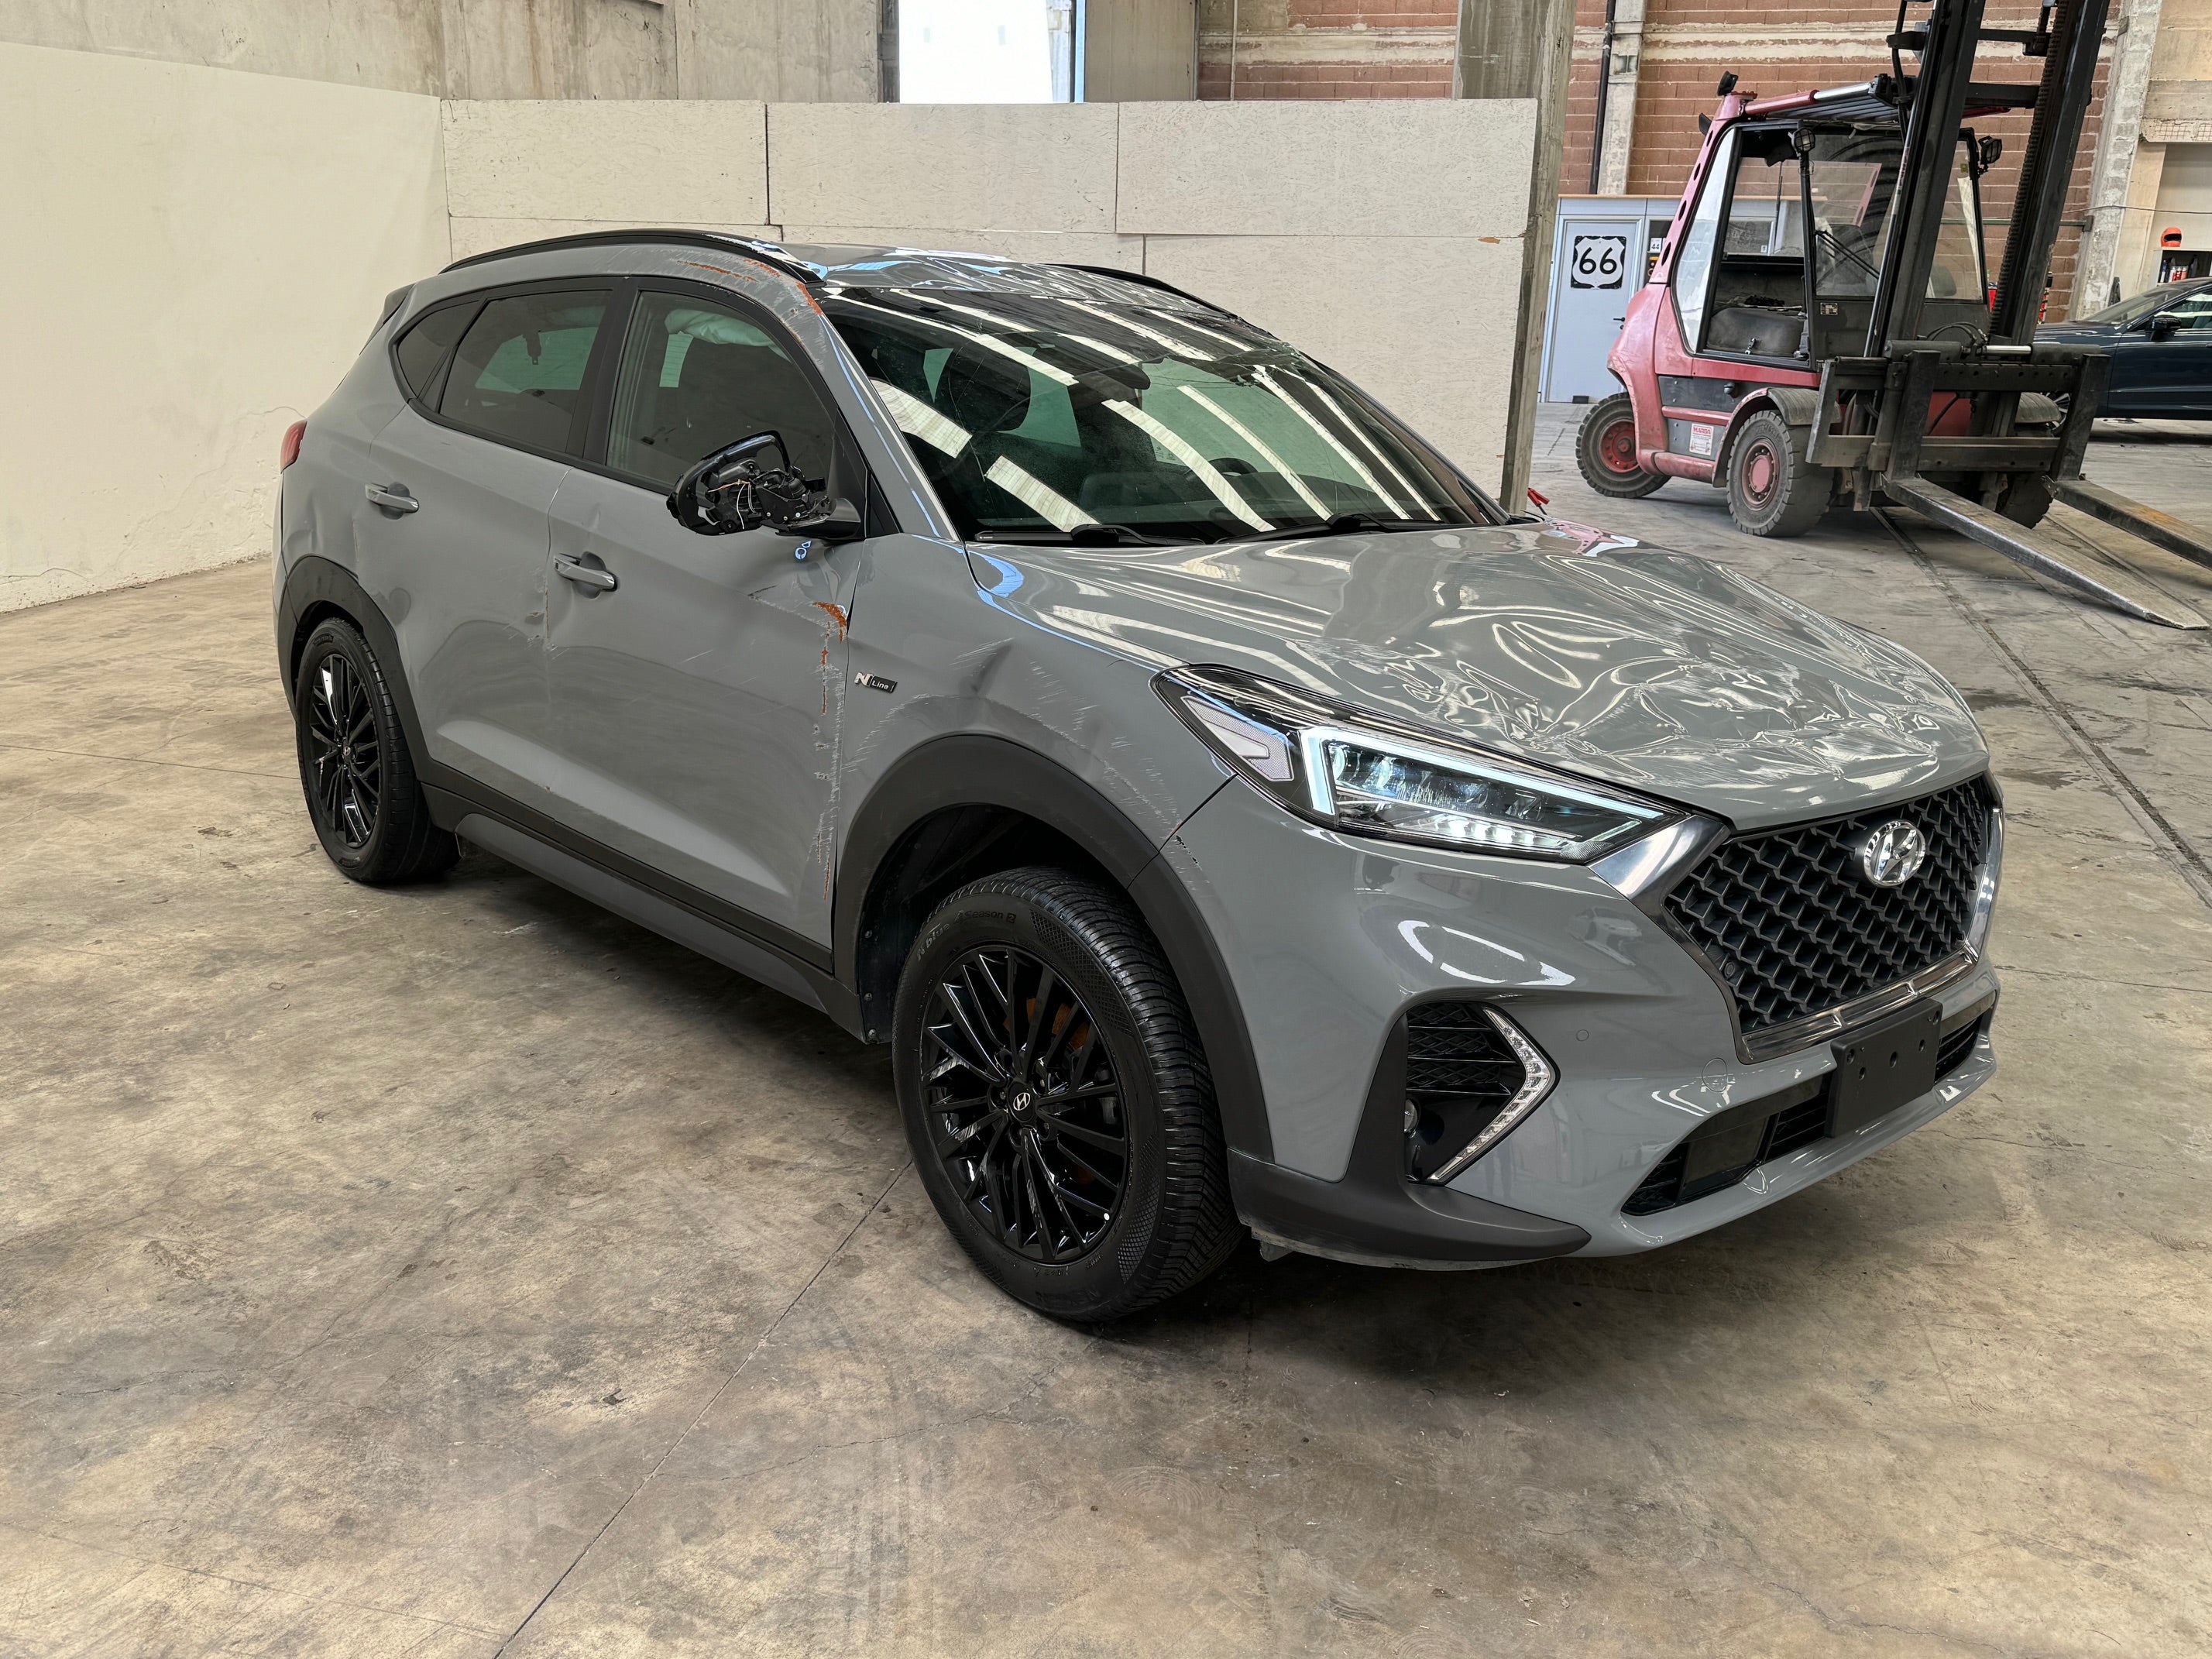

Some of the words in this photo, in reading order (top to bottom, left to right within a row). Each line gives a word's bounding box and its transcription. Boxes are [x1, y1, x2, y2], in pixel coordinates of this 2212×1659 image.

[1579, 247, 1617, 275] 66
[854, 672, 873, 687] N
[871, 680, 889, 690] Line
